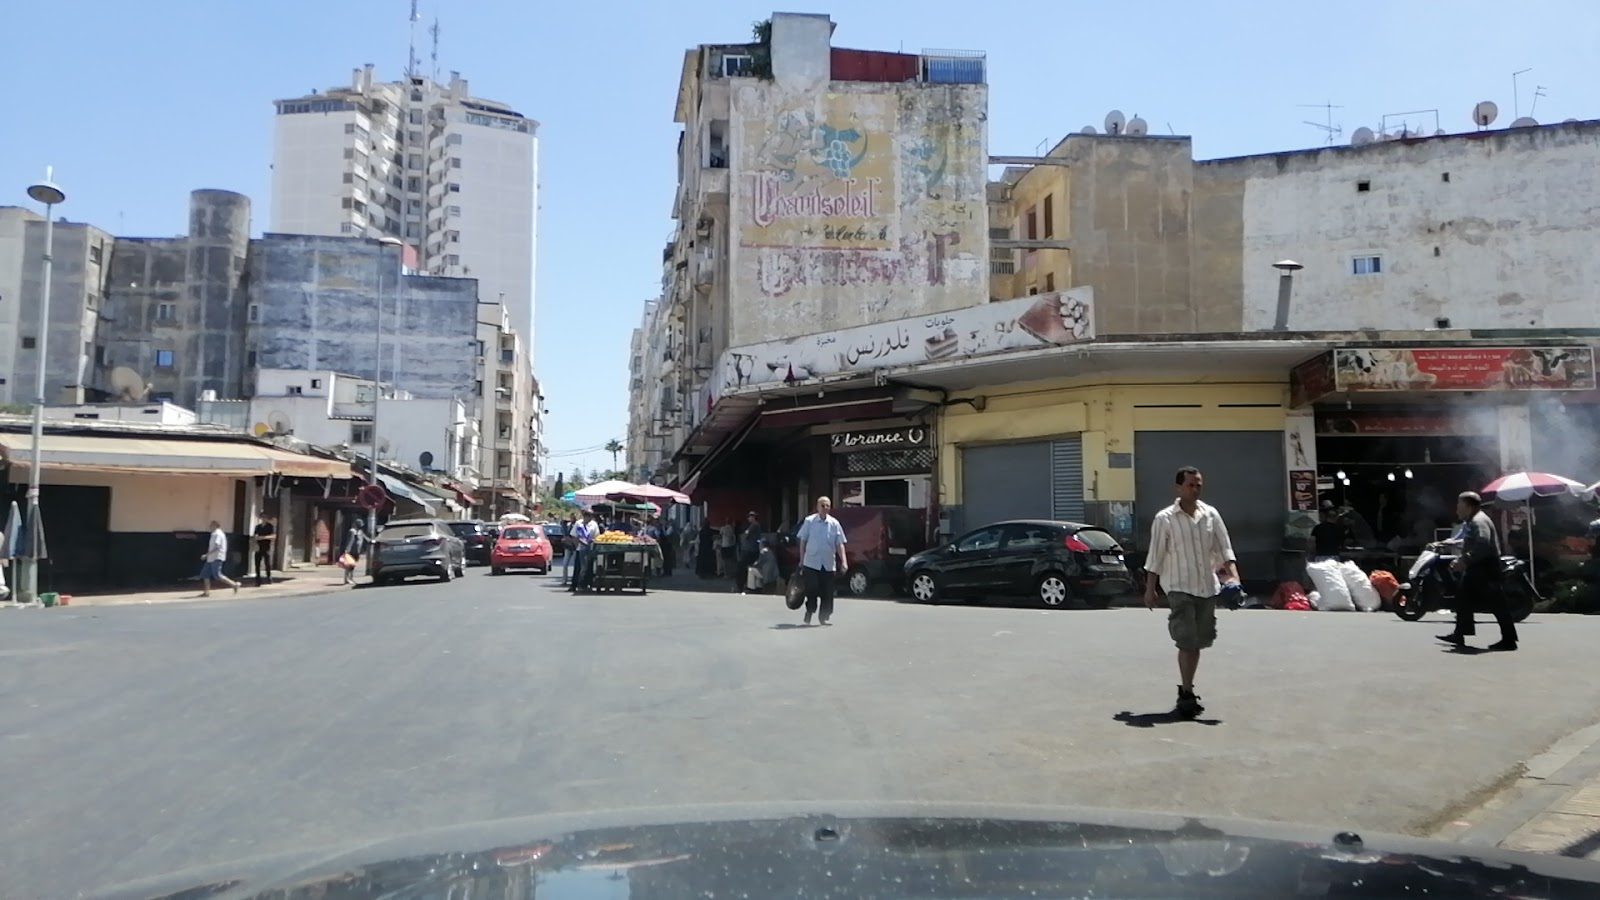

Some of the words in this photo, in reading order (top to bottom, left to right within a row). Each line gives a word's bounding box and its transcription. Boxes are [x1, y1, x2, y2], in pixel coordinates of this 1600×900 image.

[925, 315, 955, 329] حلويات
[847, 326, 910, 365] فلورنس
[831, 432, 904, 447] Florance
